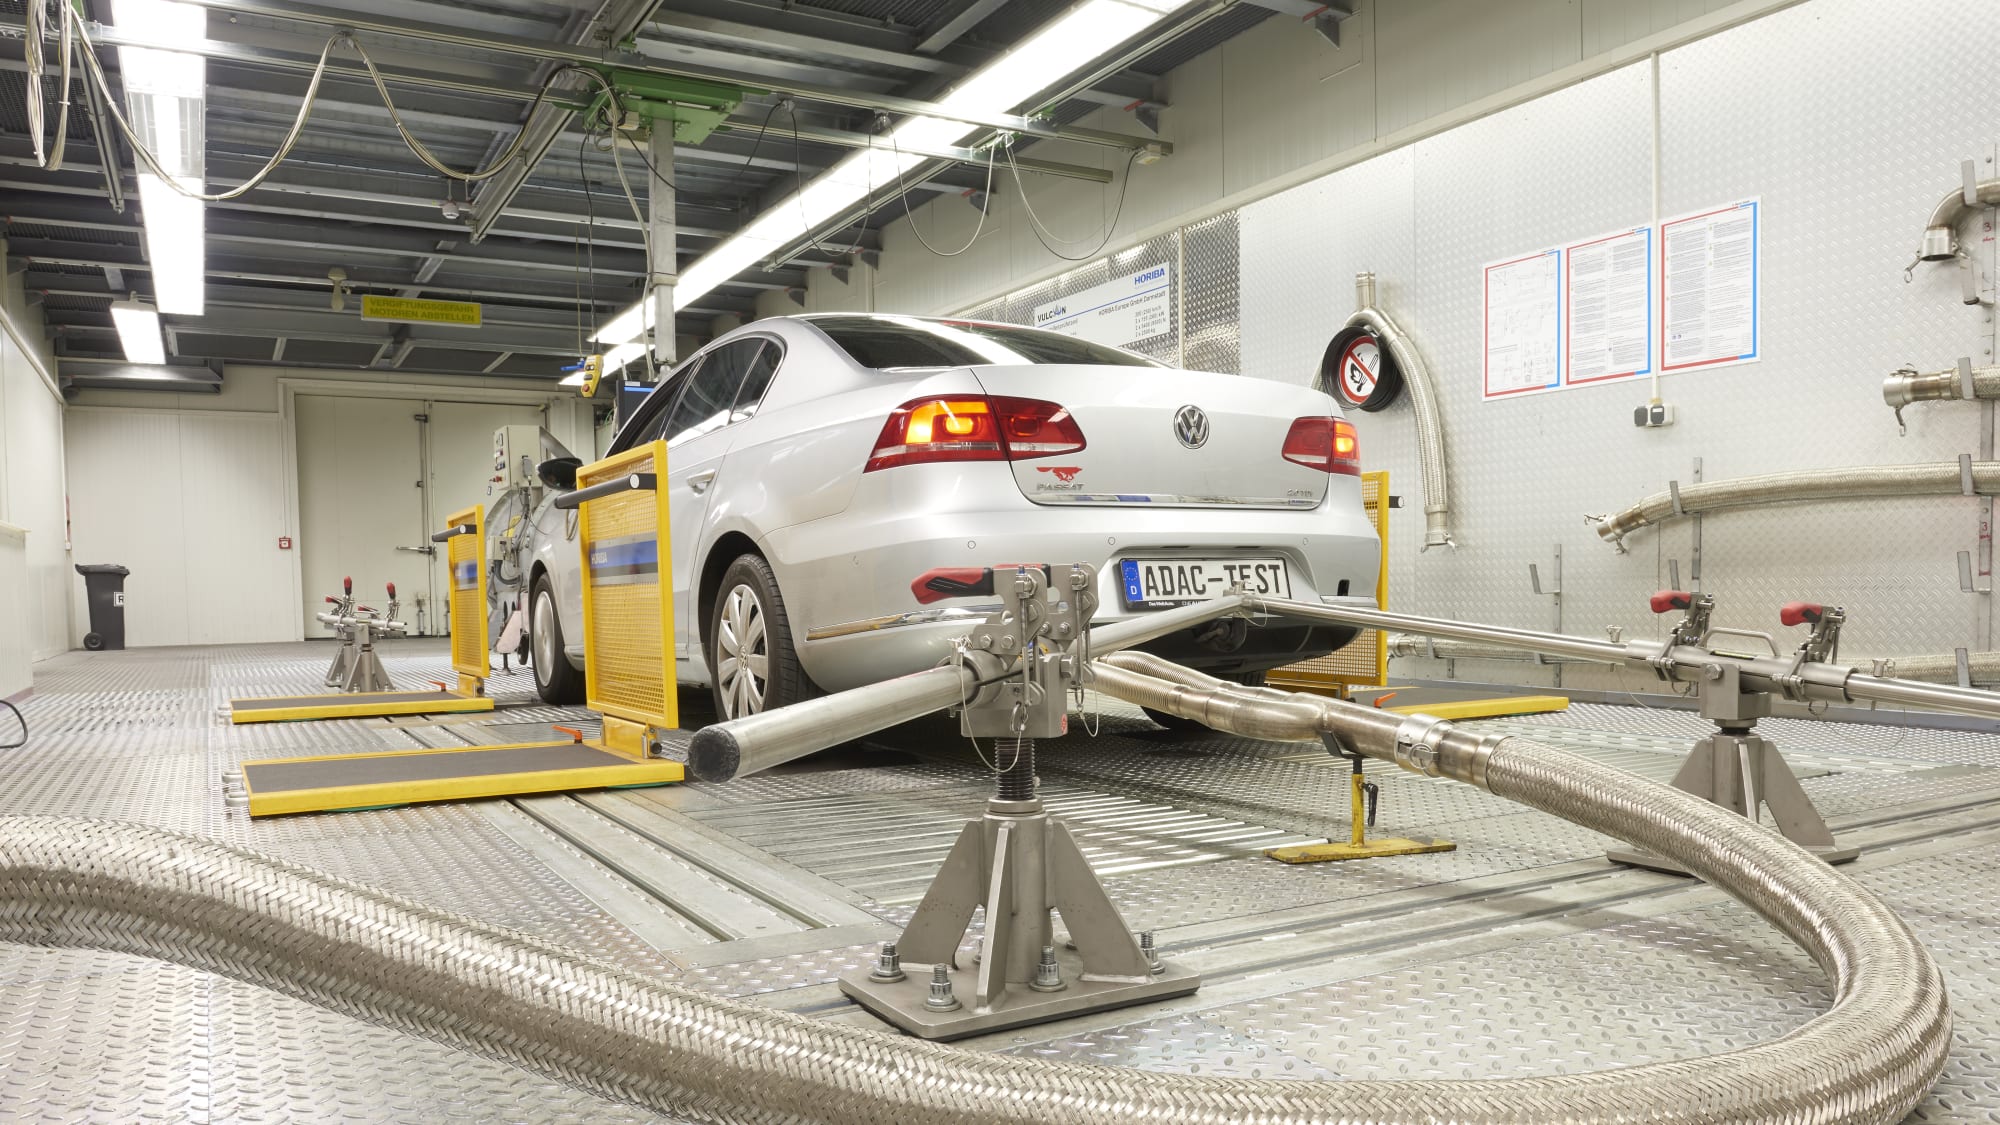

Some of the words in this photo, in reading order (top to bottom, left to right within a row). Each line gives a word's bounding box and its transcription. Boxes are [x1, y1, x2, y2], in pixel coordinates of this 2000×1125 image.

[1134, 268, 1165, 285] HORIBA
[369, 298, 474, 313] VERGIFTUNGSGEFAHR
[1115, 302, 1129, 312] Europe
[1143, 290, 1166, 303] Darmstadt
[369, 307, 418, 318] MOTOREN
[420, 311, 475, 322] ABSTELLEN
[1036, 483, 1084, 492] PASSAT
[1130, 585, 1138, 595] D
